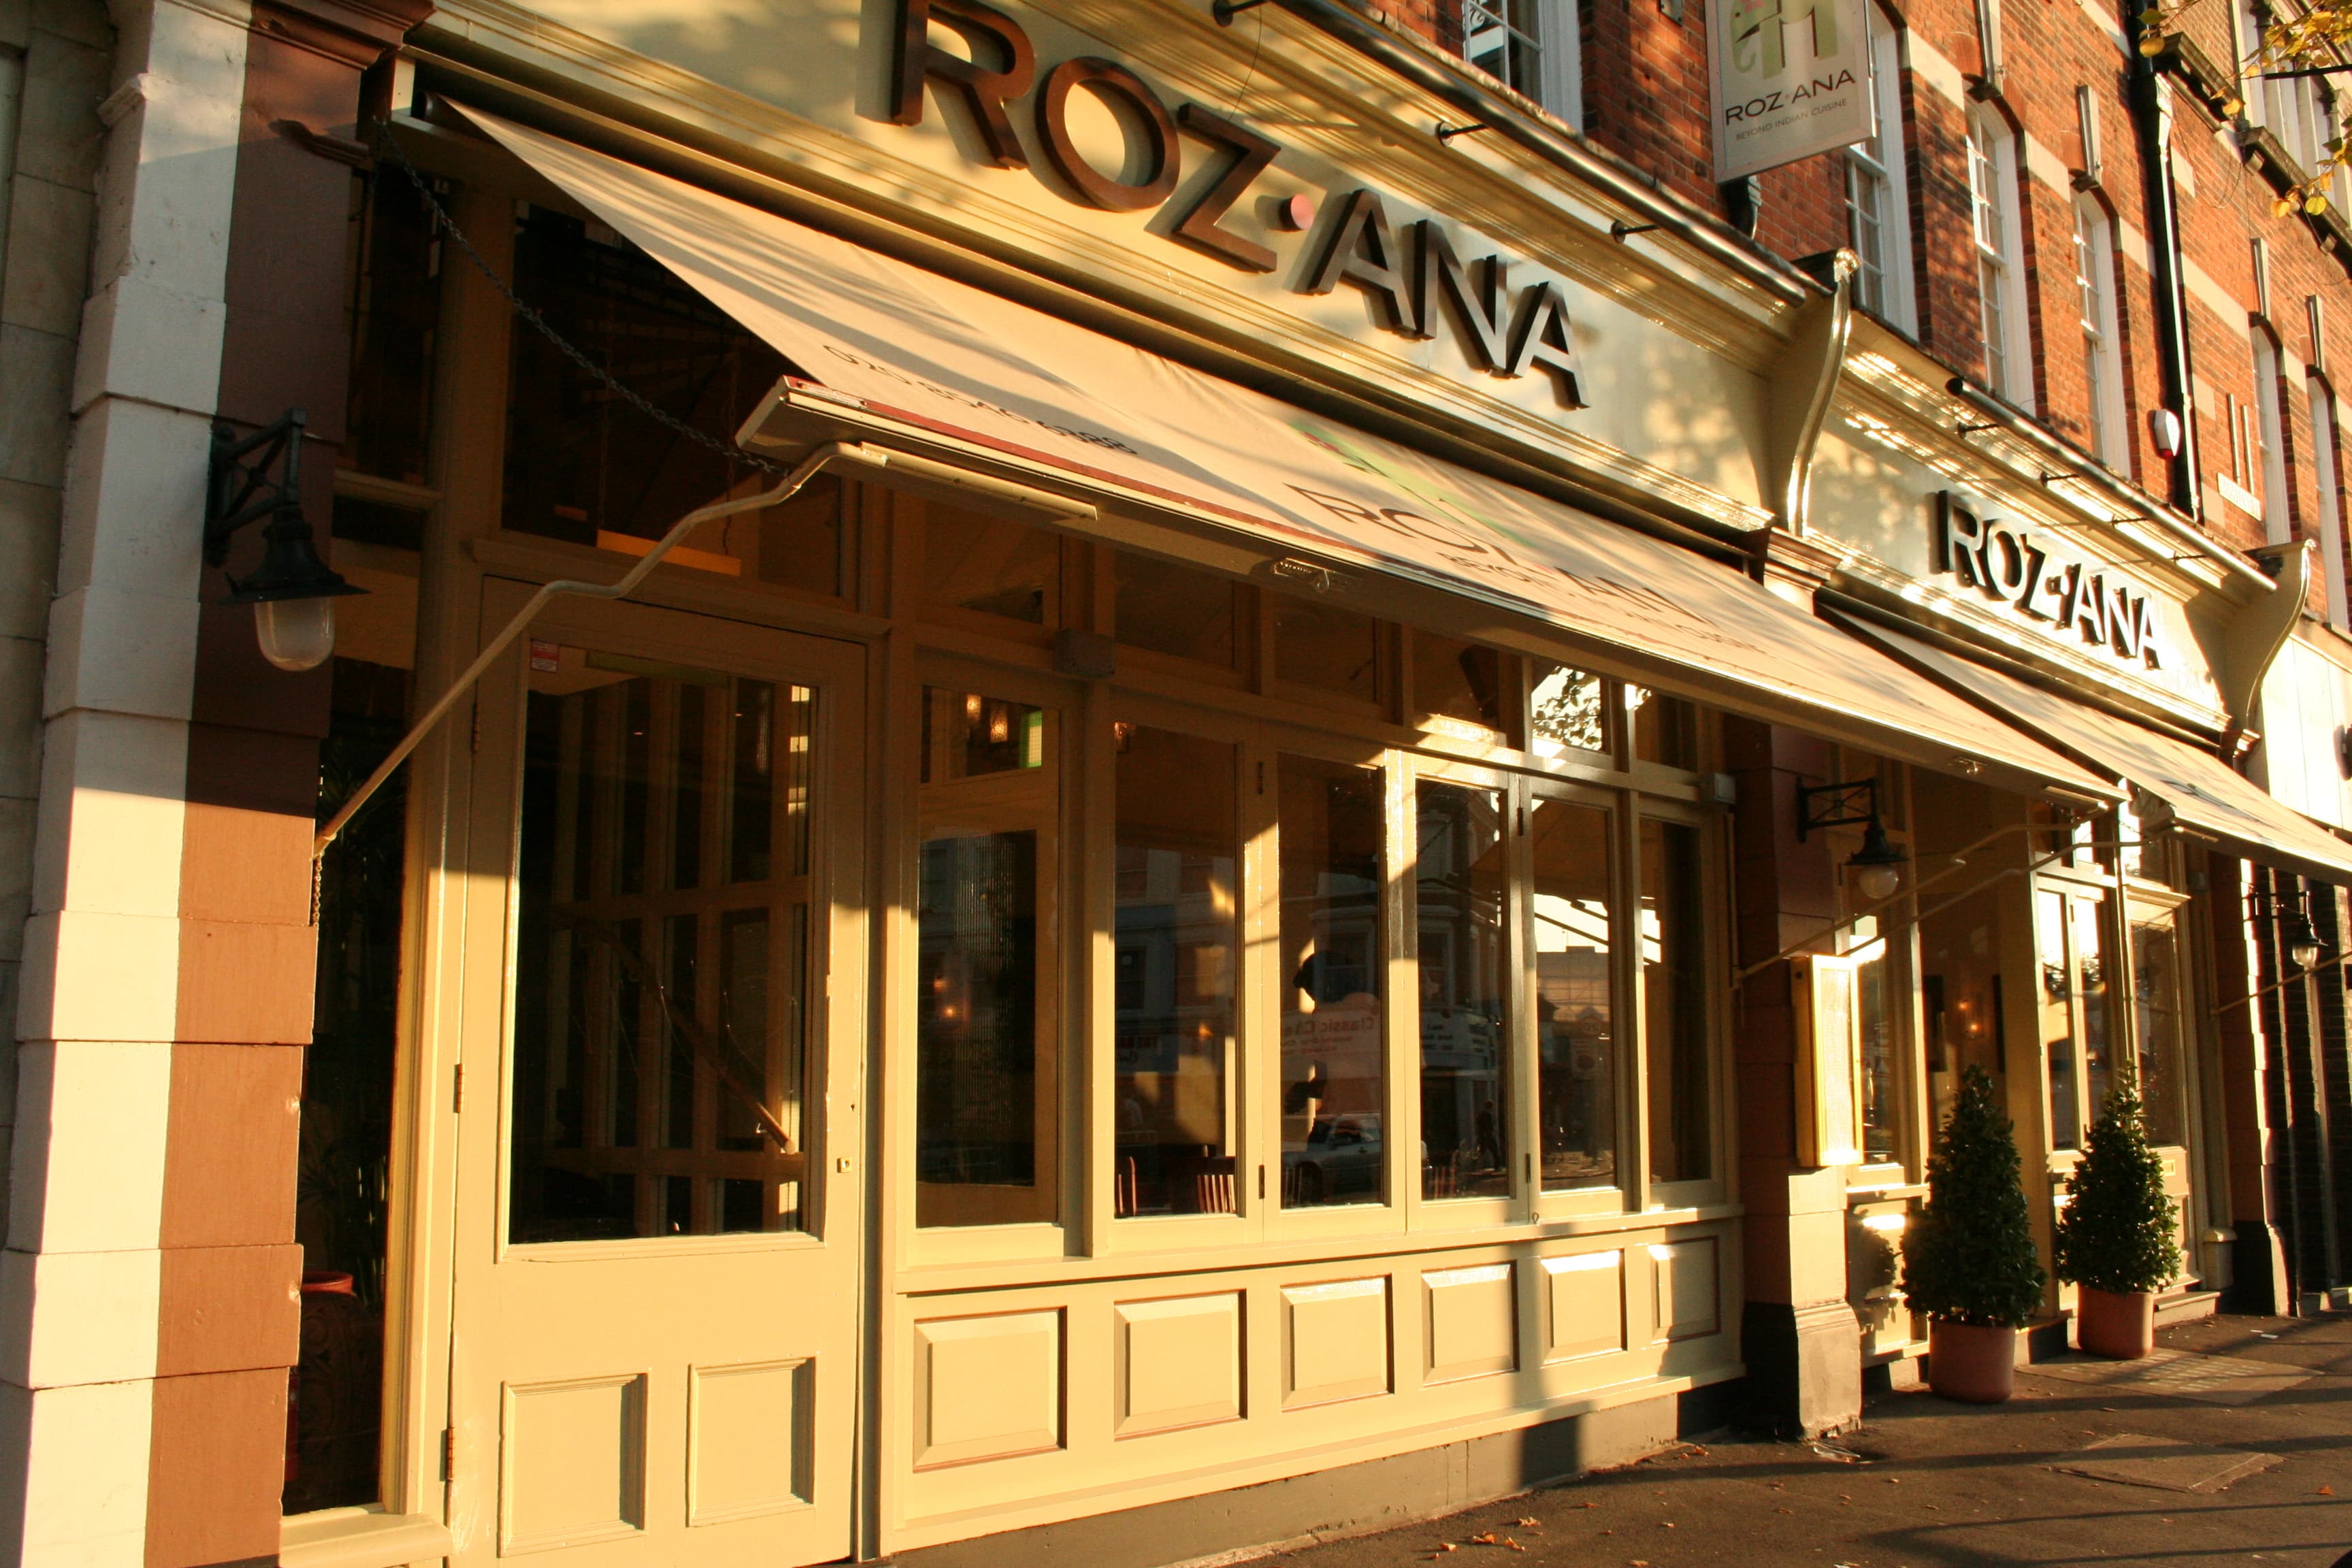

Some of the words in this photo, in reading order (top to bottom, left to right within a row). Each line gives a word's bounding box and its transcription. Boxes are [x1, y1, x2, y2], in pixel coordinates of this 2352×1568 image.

[1735, 122, 1772, 141] BEYOND
[1775, 112, 1808, 127] INDIAN
[1811, 98, 1847, 116] CUISINE
